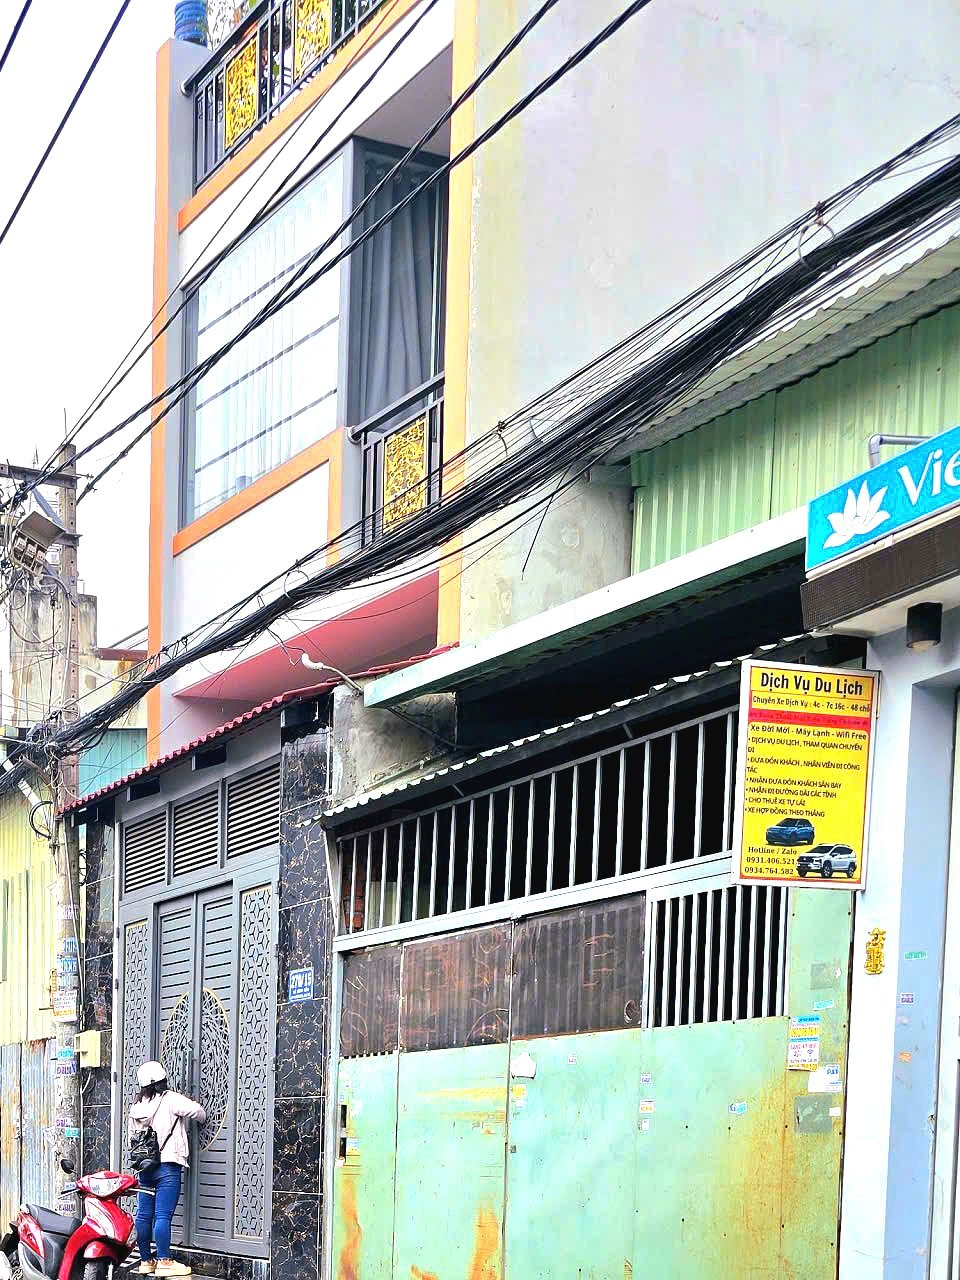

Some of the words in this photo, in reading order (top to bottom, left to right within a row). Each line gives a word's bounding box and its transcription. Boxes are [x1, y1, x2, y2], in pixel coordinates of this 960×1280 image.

[761, 673, 788, 692] Dịch
[794, 676, 810, 694] Vụ
[816, 678, 831, 692] Du
[836, 679, 862, 698] Lịch
[796, 728, 810, 736] Máy
[813, 729, 830, 738] Lạnh
